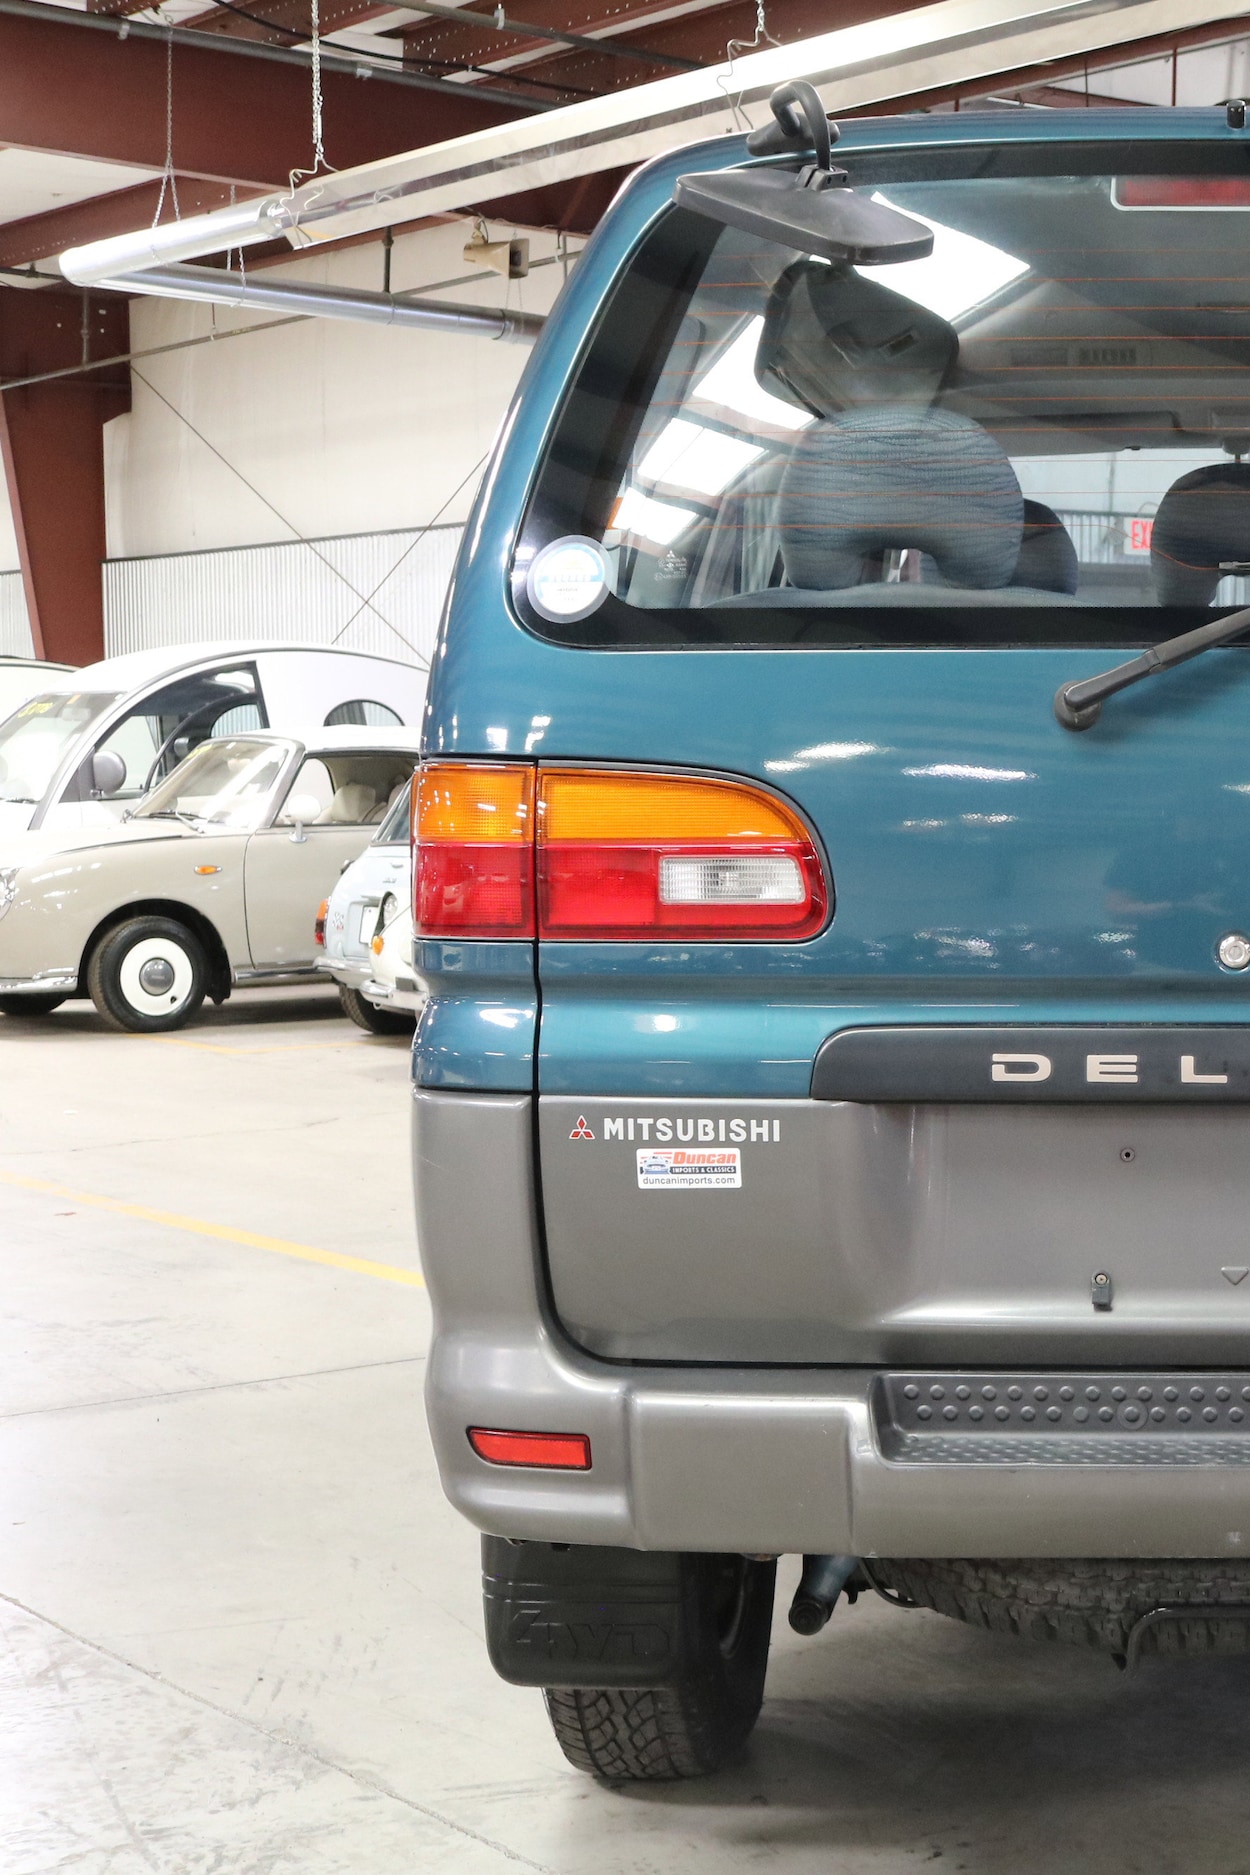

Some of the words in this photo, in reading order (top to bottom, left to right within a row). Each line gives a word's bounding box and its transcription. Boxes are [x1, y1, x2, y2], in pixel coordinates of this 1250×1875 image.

[603, 1117, 780, 1142] MITSUBISHI
[672, 1151, 737, 1164] Duncan
[643, 1176, 736, 1186] duncanimports.com
